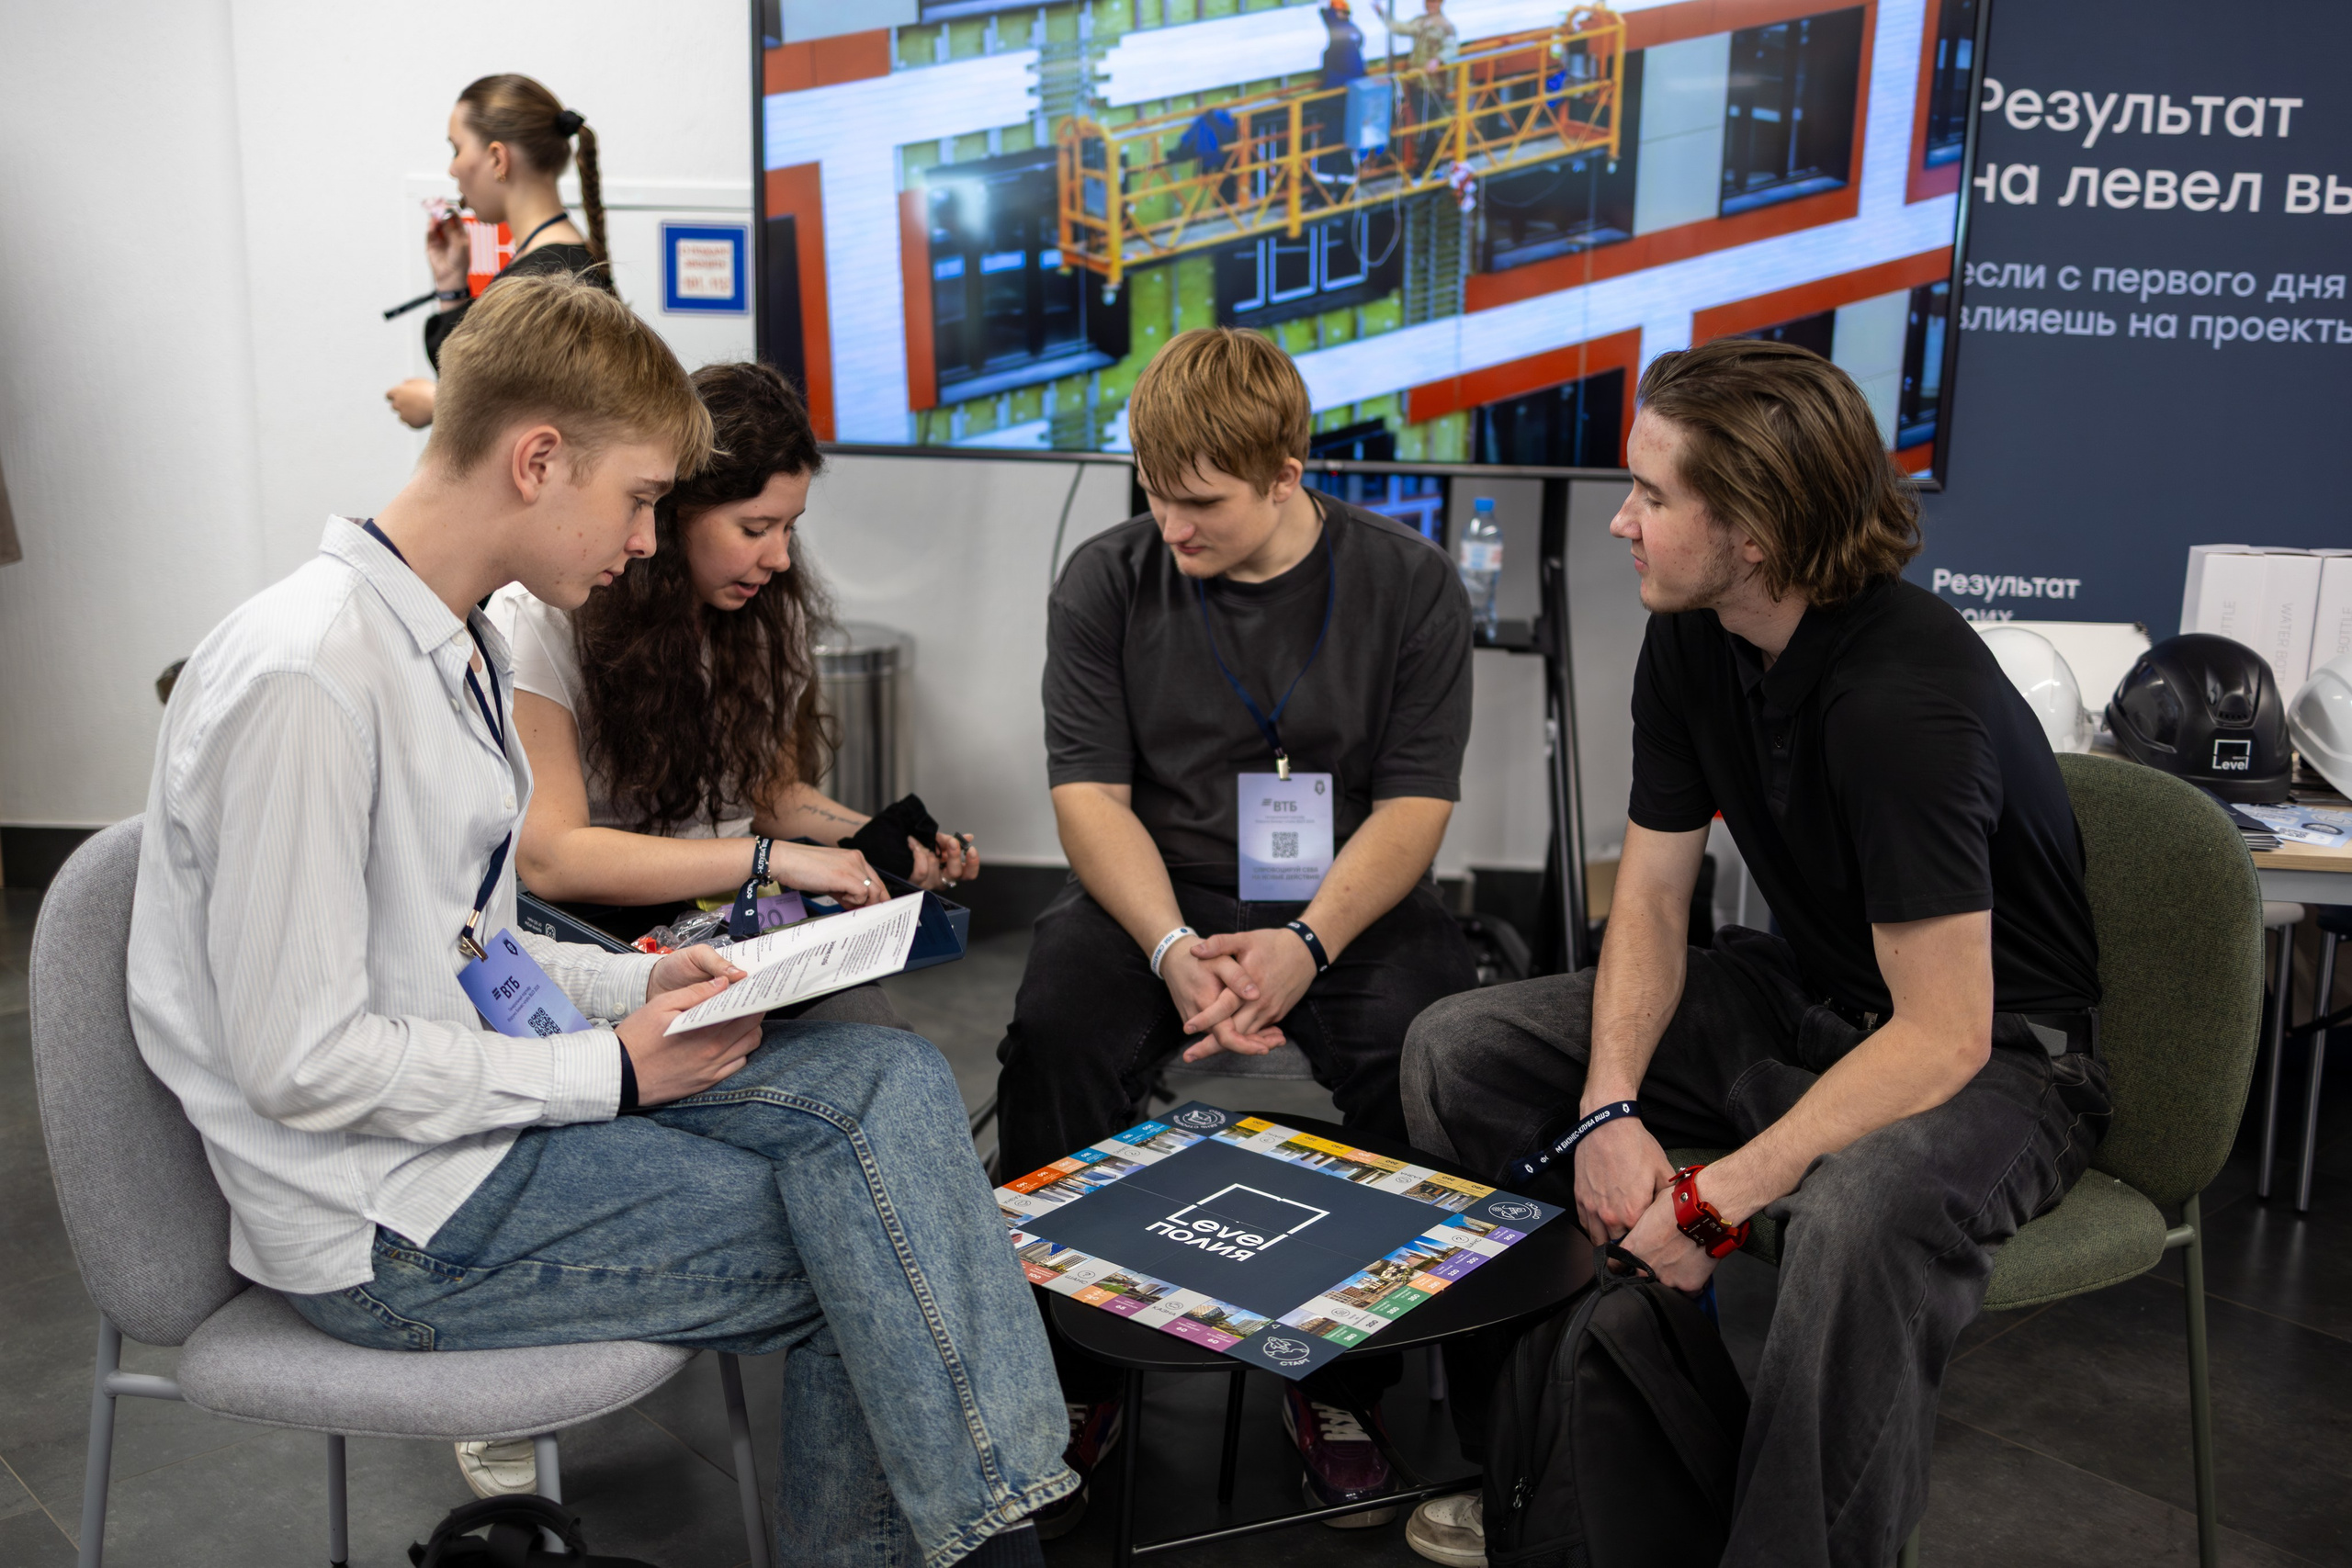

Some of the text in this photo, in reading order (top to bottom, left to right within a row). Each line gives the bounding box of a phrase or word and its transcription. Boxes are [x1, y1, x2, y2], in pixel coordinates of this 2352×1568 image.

[2058, 166, 2263, 212] левел
[2057, 265, 2081, 291] с
[2092, 267, 2256, 303] первого
[2266, 273, 2346, 303] дня
[2128, 312, 2177, 340] на
[1932, 568, 2082, 604] Результат
[2212, 755, 2250, 770] Level
[1273, 800, 1298, 812] ВТБ
[500, 976, 520, 999] ВТБ
[1560, 1118, 1596, 1150] БИЗНЕС-КЛУБА
[1594, 1110, 1611, 1122] ВШЭ
[1166, 1204, 1289, 1251] Level
[1064, 1274, 1088, 1285] ШАНС
[1152, 1305, 1176, 1315] КАЗНА
[1279, 1358, 1311, 1367] СТАРТ
